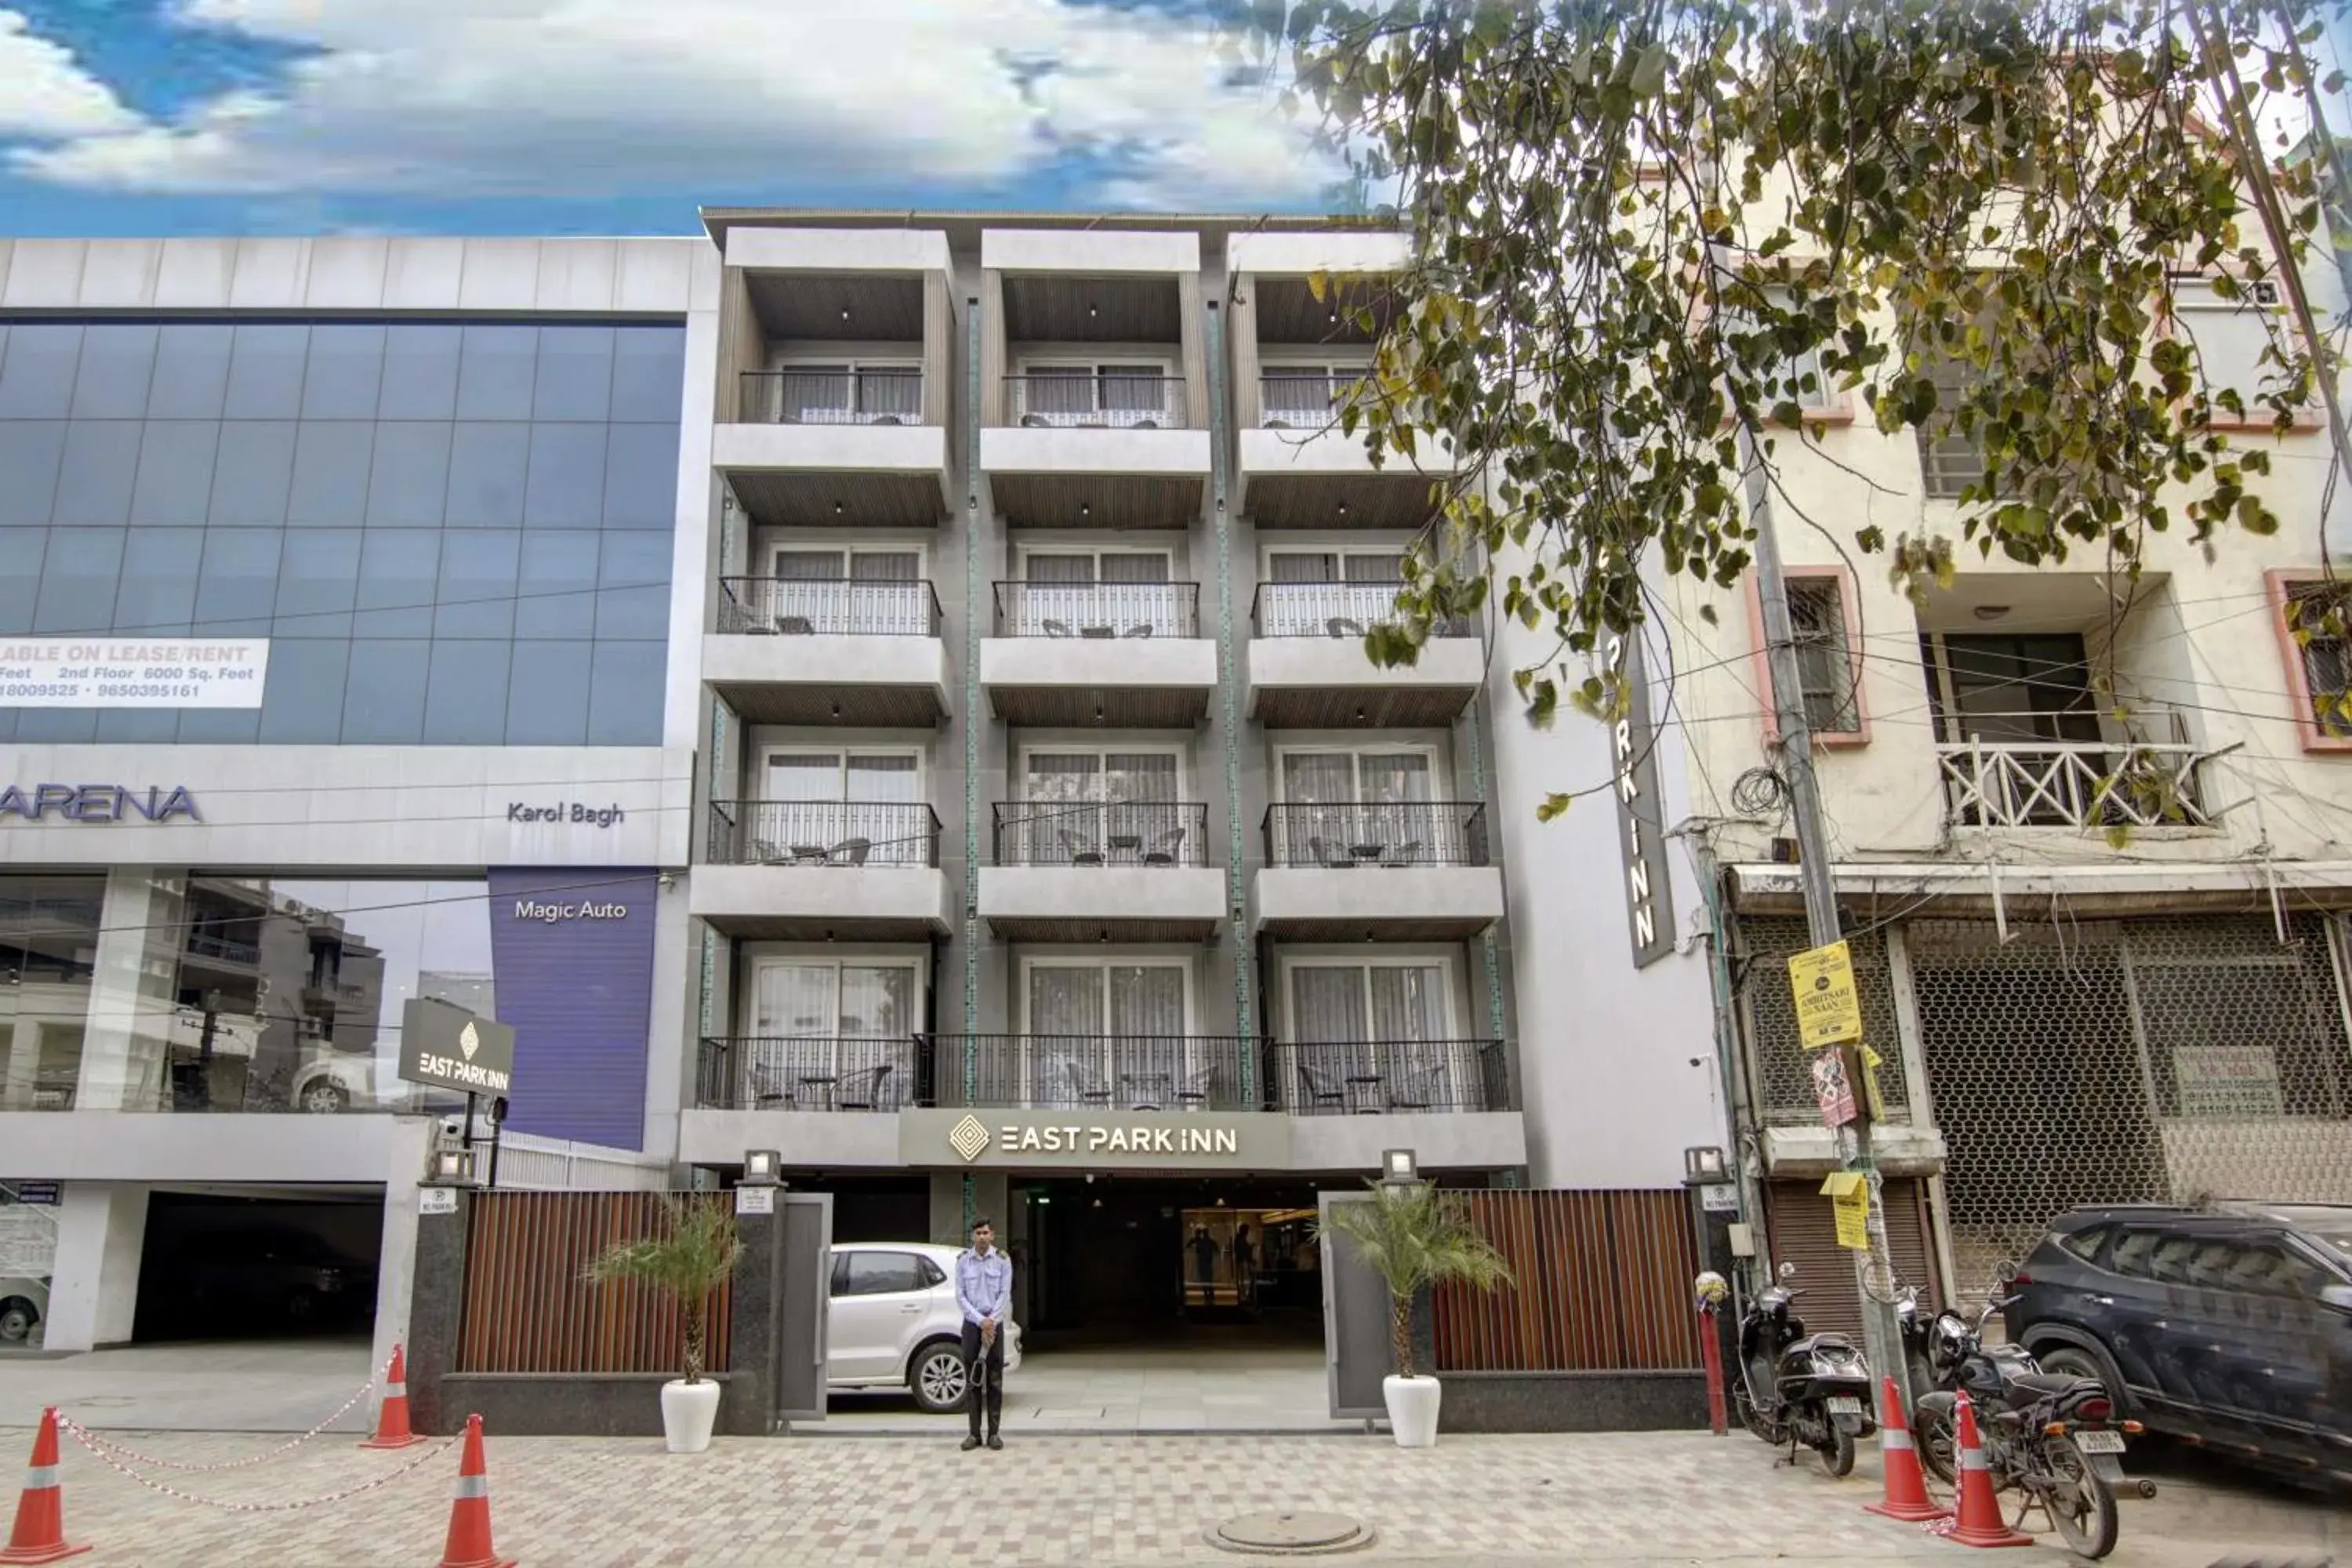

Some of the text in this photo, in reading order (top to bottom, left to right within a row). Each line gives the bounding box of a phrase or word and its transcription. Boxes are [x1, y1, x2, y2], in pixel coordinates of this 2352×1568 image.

[0, 645, 249, 662] ABLE ON LEASE/RENT
[58, 667, 89, 679] 2nd
[94, 667, 135, 679] Floor
[144, 667, 183, 680] 6000
[188, 667, 212, 683] Sq.
[218, 667, 253, 680] Feet
[1608, 636, 1638, 804] PRK
[0, 784, 201, 821] ARENA
[507, 802, 625, 828] Karol Bagh
[515, 901, 627, 922] Magic Auto
[419, 1052, 453, 1078] EAST
[454, 1061, 487, 1086] PARK
[1001, 1126, 1081, 1151] EAST
[1089, 1127, 1174, 1152] PARK
